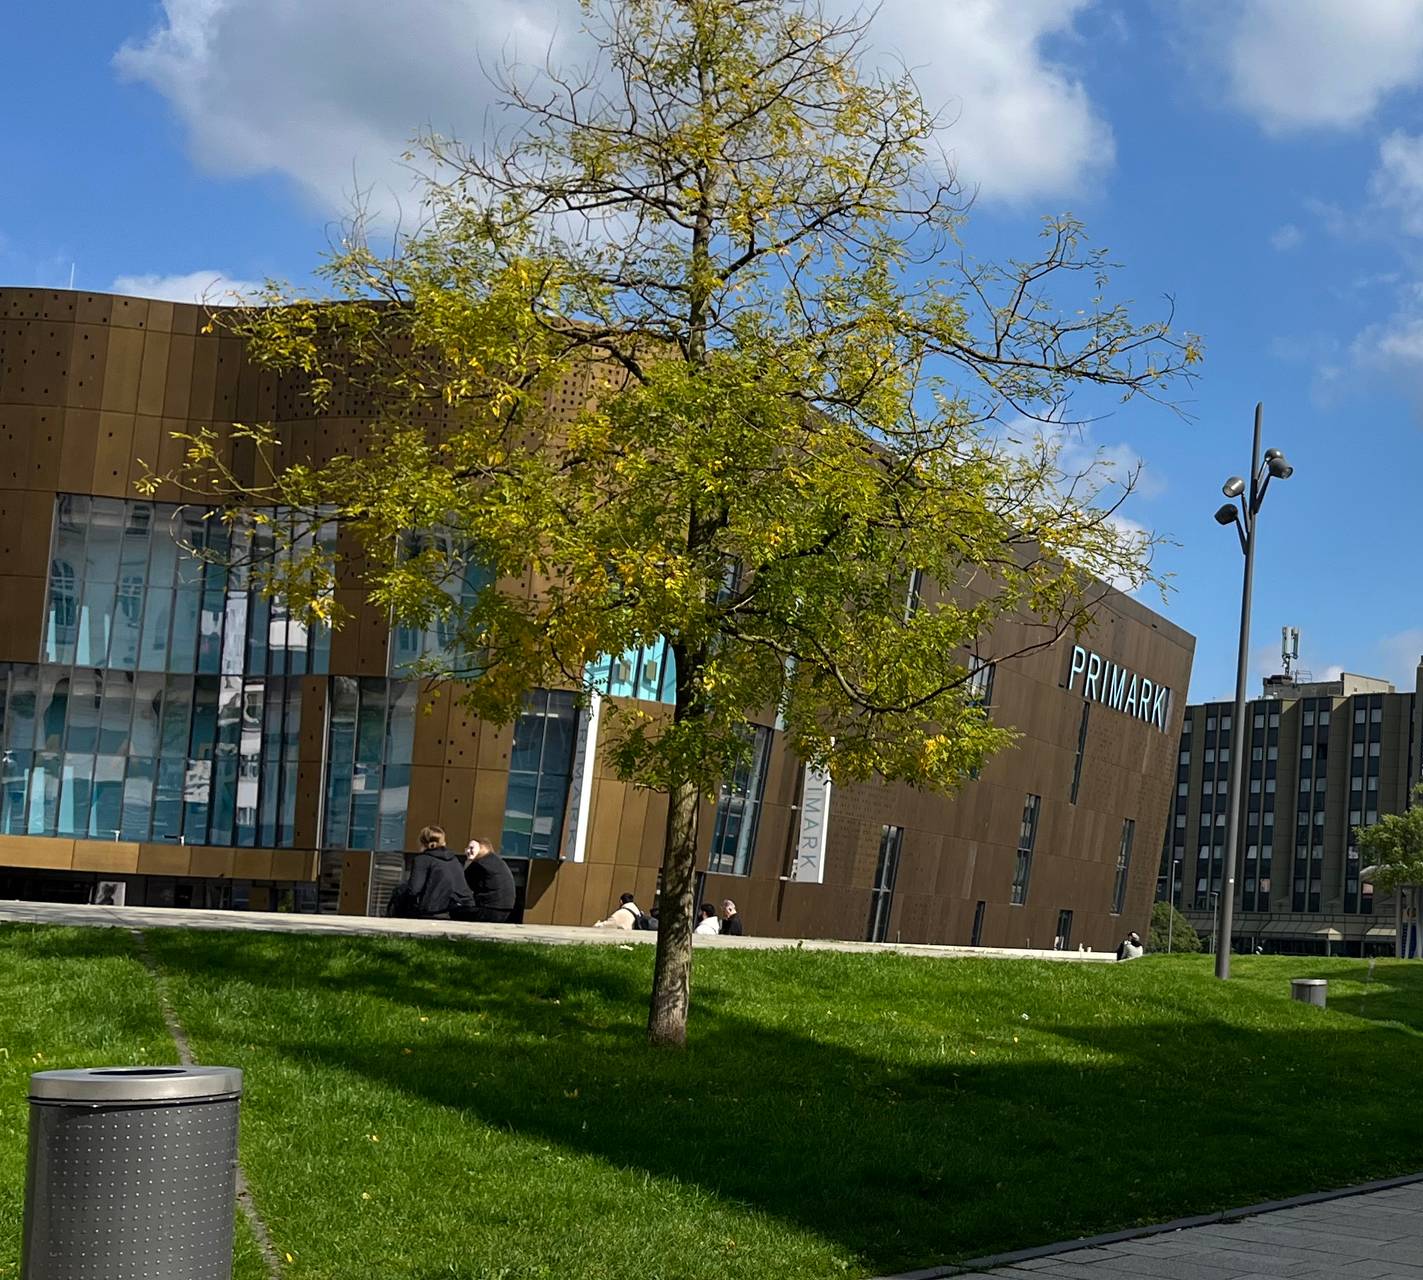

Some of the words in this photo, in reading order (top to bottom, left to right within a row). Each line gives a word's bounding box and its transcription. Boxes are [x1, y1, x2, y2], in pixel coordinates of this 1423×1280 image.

[1068, 645, 1167, 734] PRIMARK
[568, 711, 588, 844] RIMARK
[799, 756, 824, 869] RIMARK
